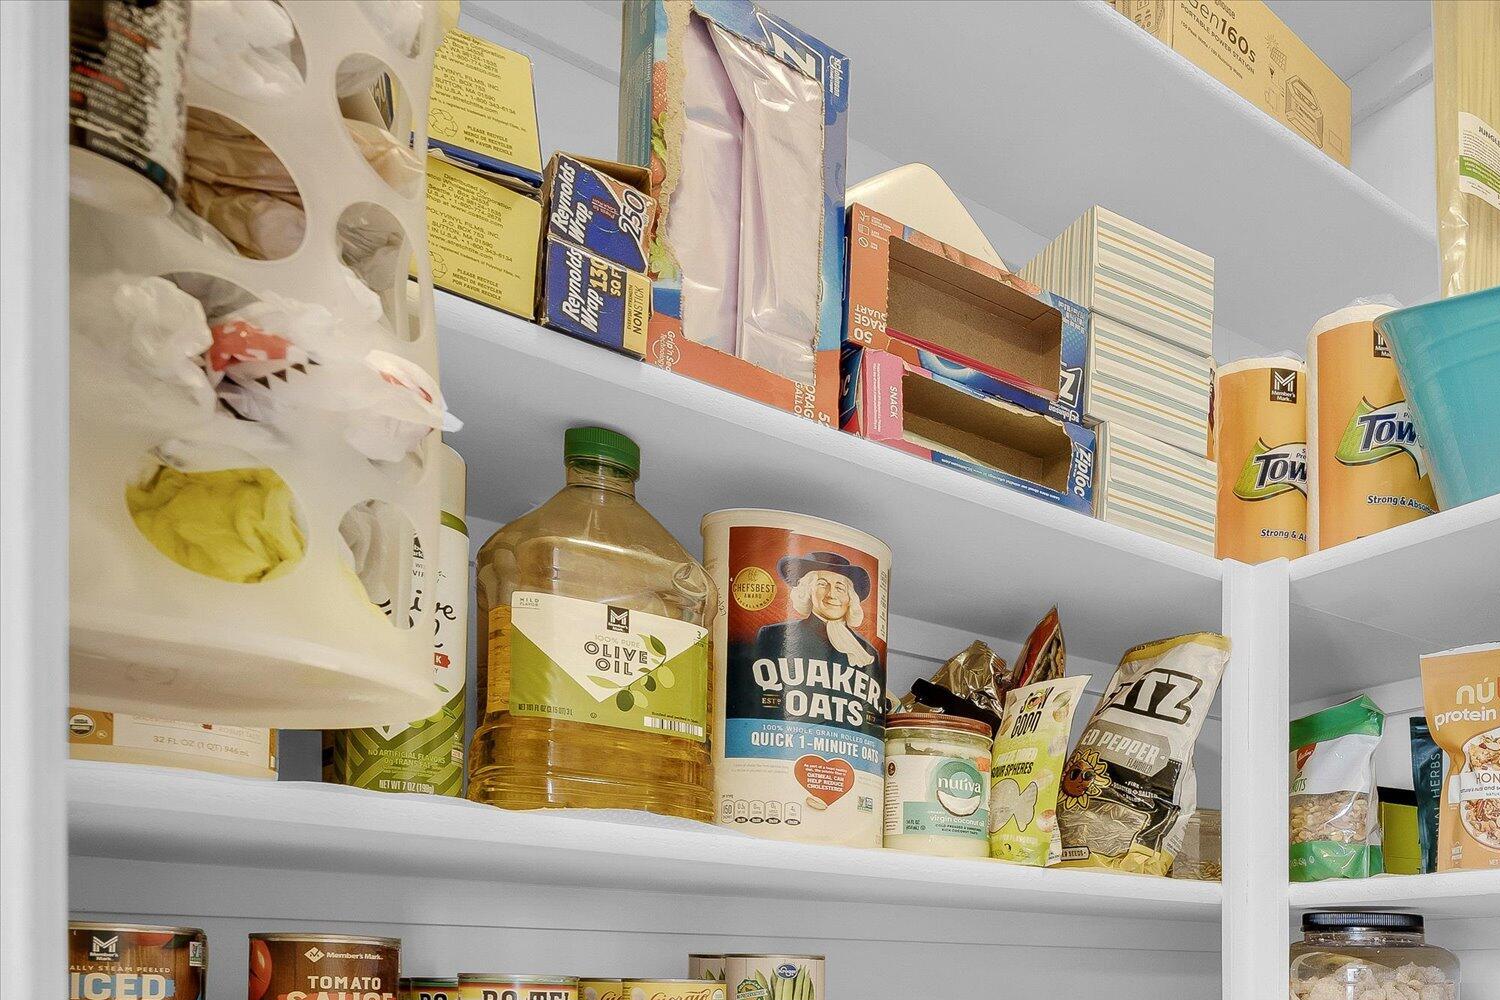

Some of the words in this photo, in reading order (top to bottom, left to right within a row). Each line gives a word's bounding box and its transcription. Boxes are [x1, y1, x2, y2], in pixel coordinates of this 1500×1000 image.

[551, 161, 576, 232] Reynolds
[567, 202, 587, 244] Wrap
[632, 287, 646, 335] NONSTICK
[889, 385, 899, 419] SNACK
[1074, 446, 1093, 498] Ziploc
[1367, 496, 1398, 506] Strong
[1261, 529, 1289, 538] Strong
[733, 583, 776, 593] CHEFSBEST
[584, 641, 648, 665] OLIVE
[595, 658, 633, 676] OIL
[785, 690, 864, 727] OATS
[1434, 706, 1496, 731] protein
[751, 732, 793, 748] QUICK
[799, 734, 860, 758] 1-MINUTE
[1100, 731, 1160, 764] PEPPER
[937, 774, 982, 794] nutiva
[326, 952, 363, 960] Member's
[307, 975, 381, 990] TOMATO
